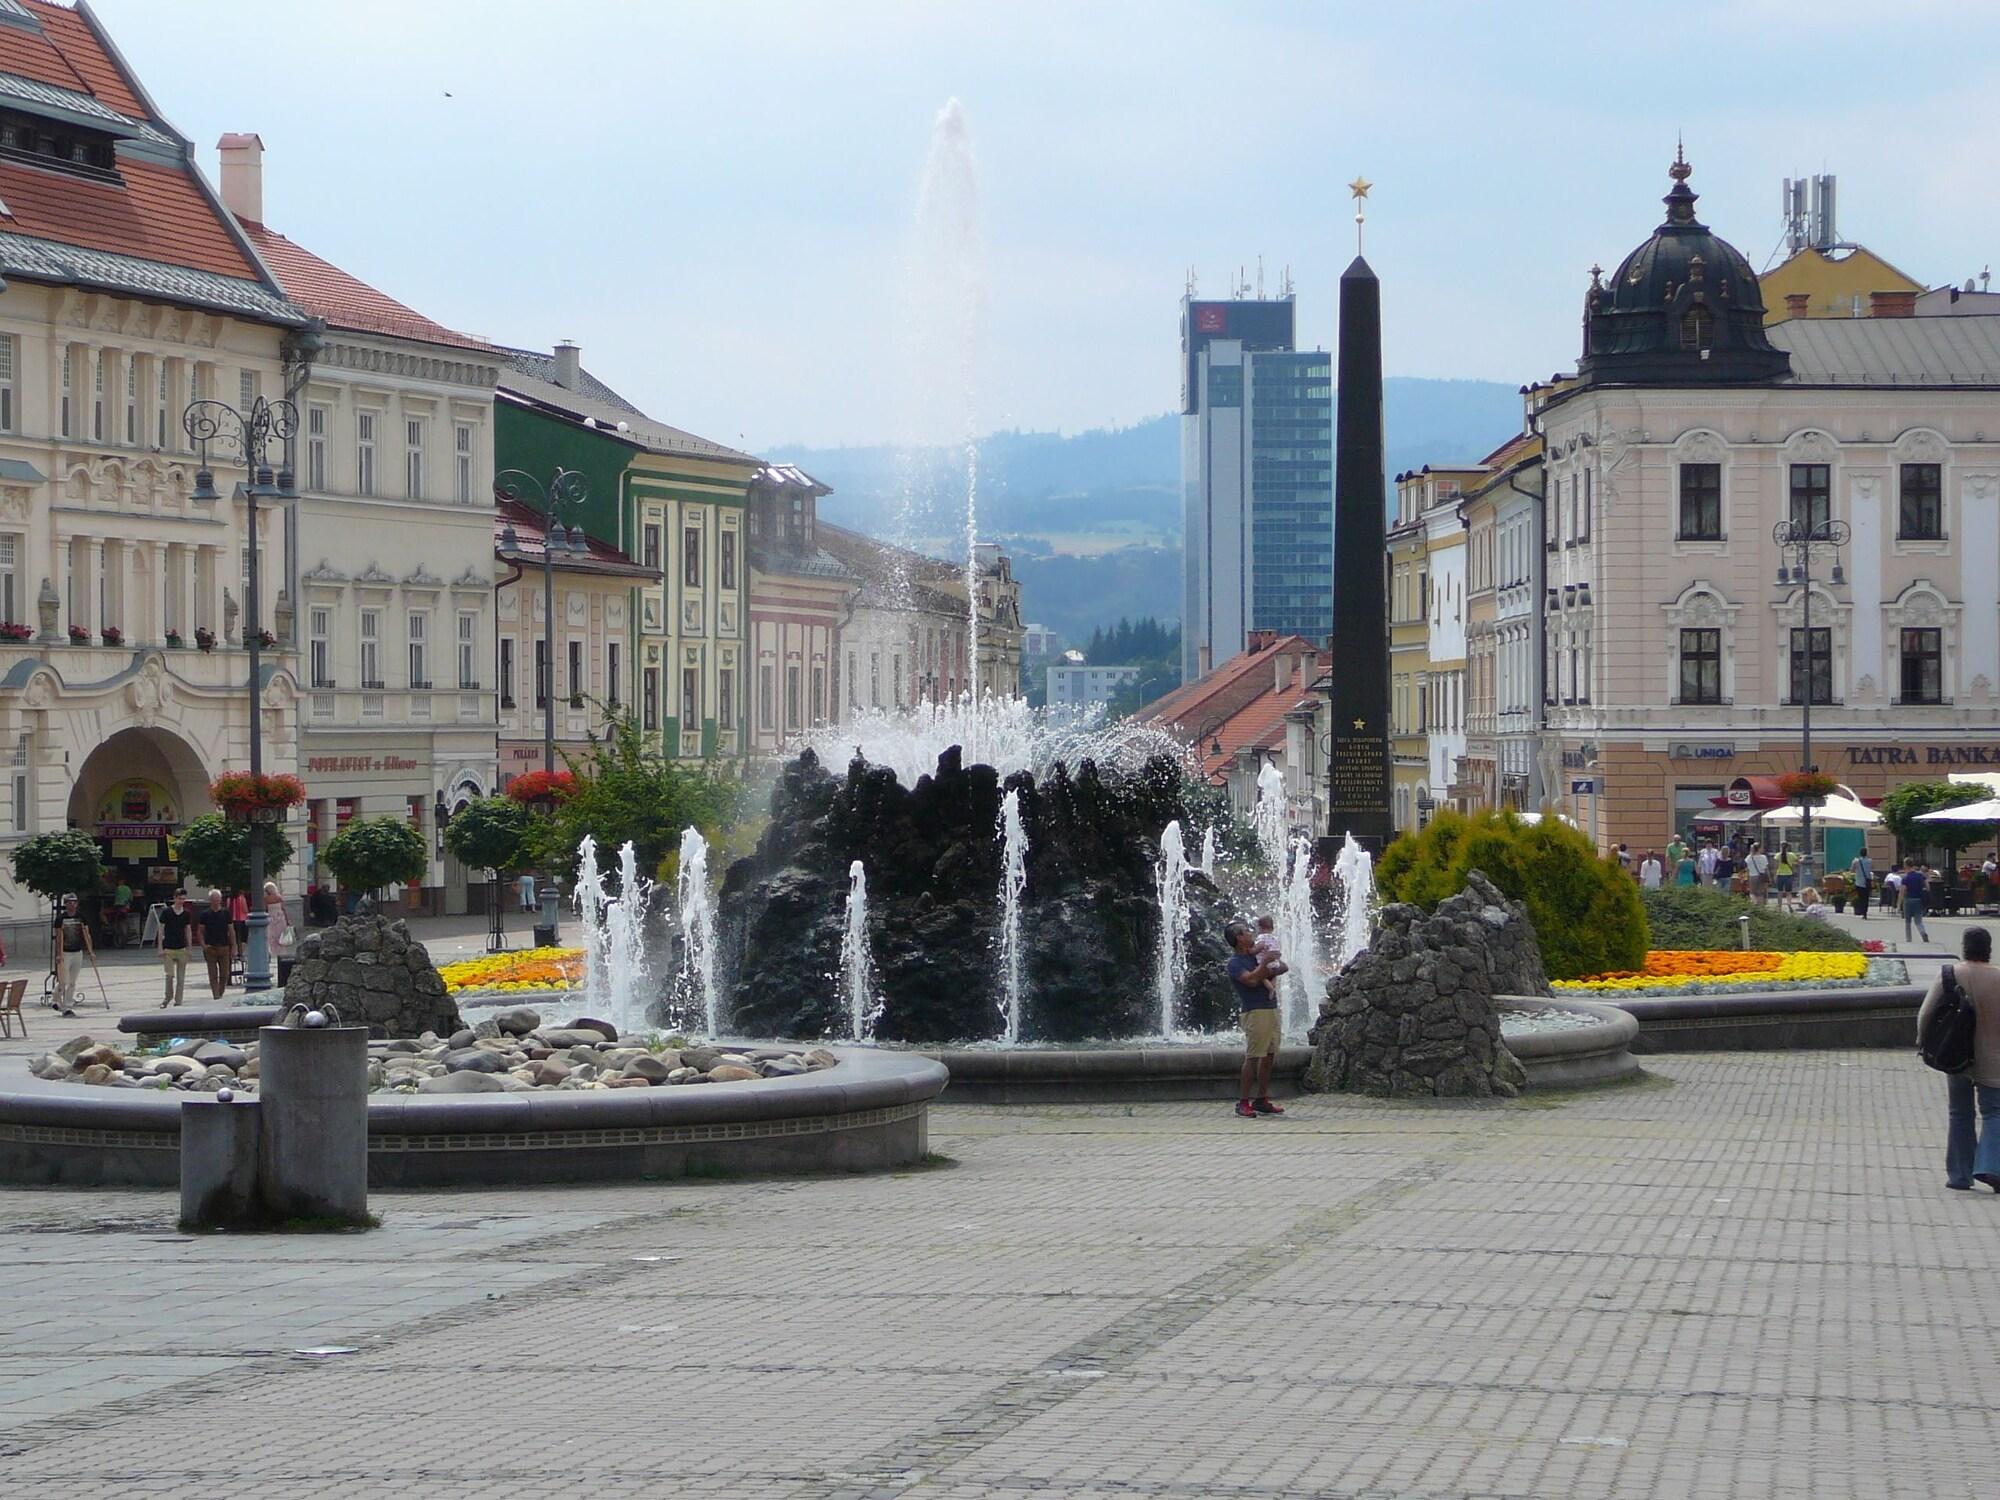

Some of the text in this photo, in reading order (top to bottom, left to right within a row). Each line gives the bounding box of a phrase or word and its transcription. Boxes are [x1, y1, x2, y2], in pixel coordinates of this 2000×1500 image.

[1695, 748, 1734, 758] UNIQA
[1846, 747, 1919, 764] TATRA
[308, 757, 372, 772] POTRAVINY
